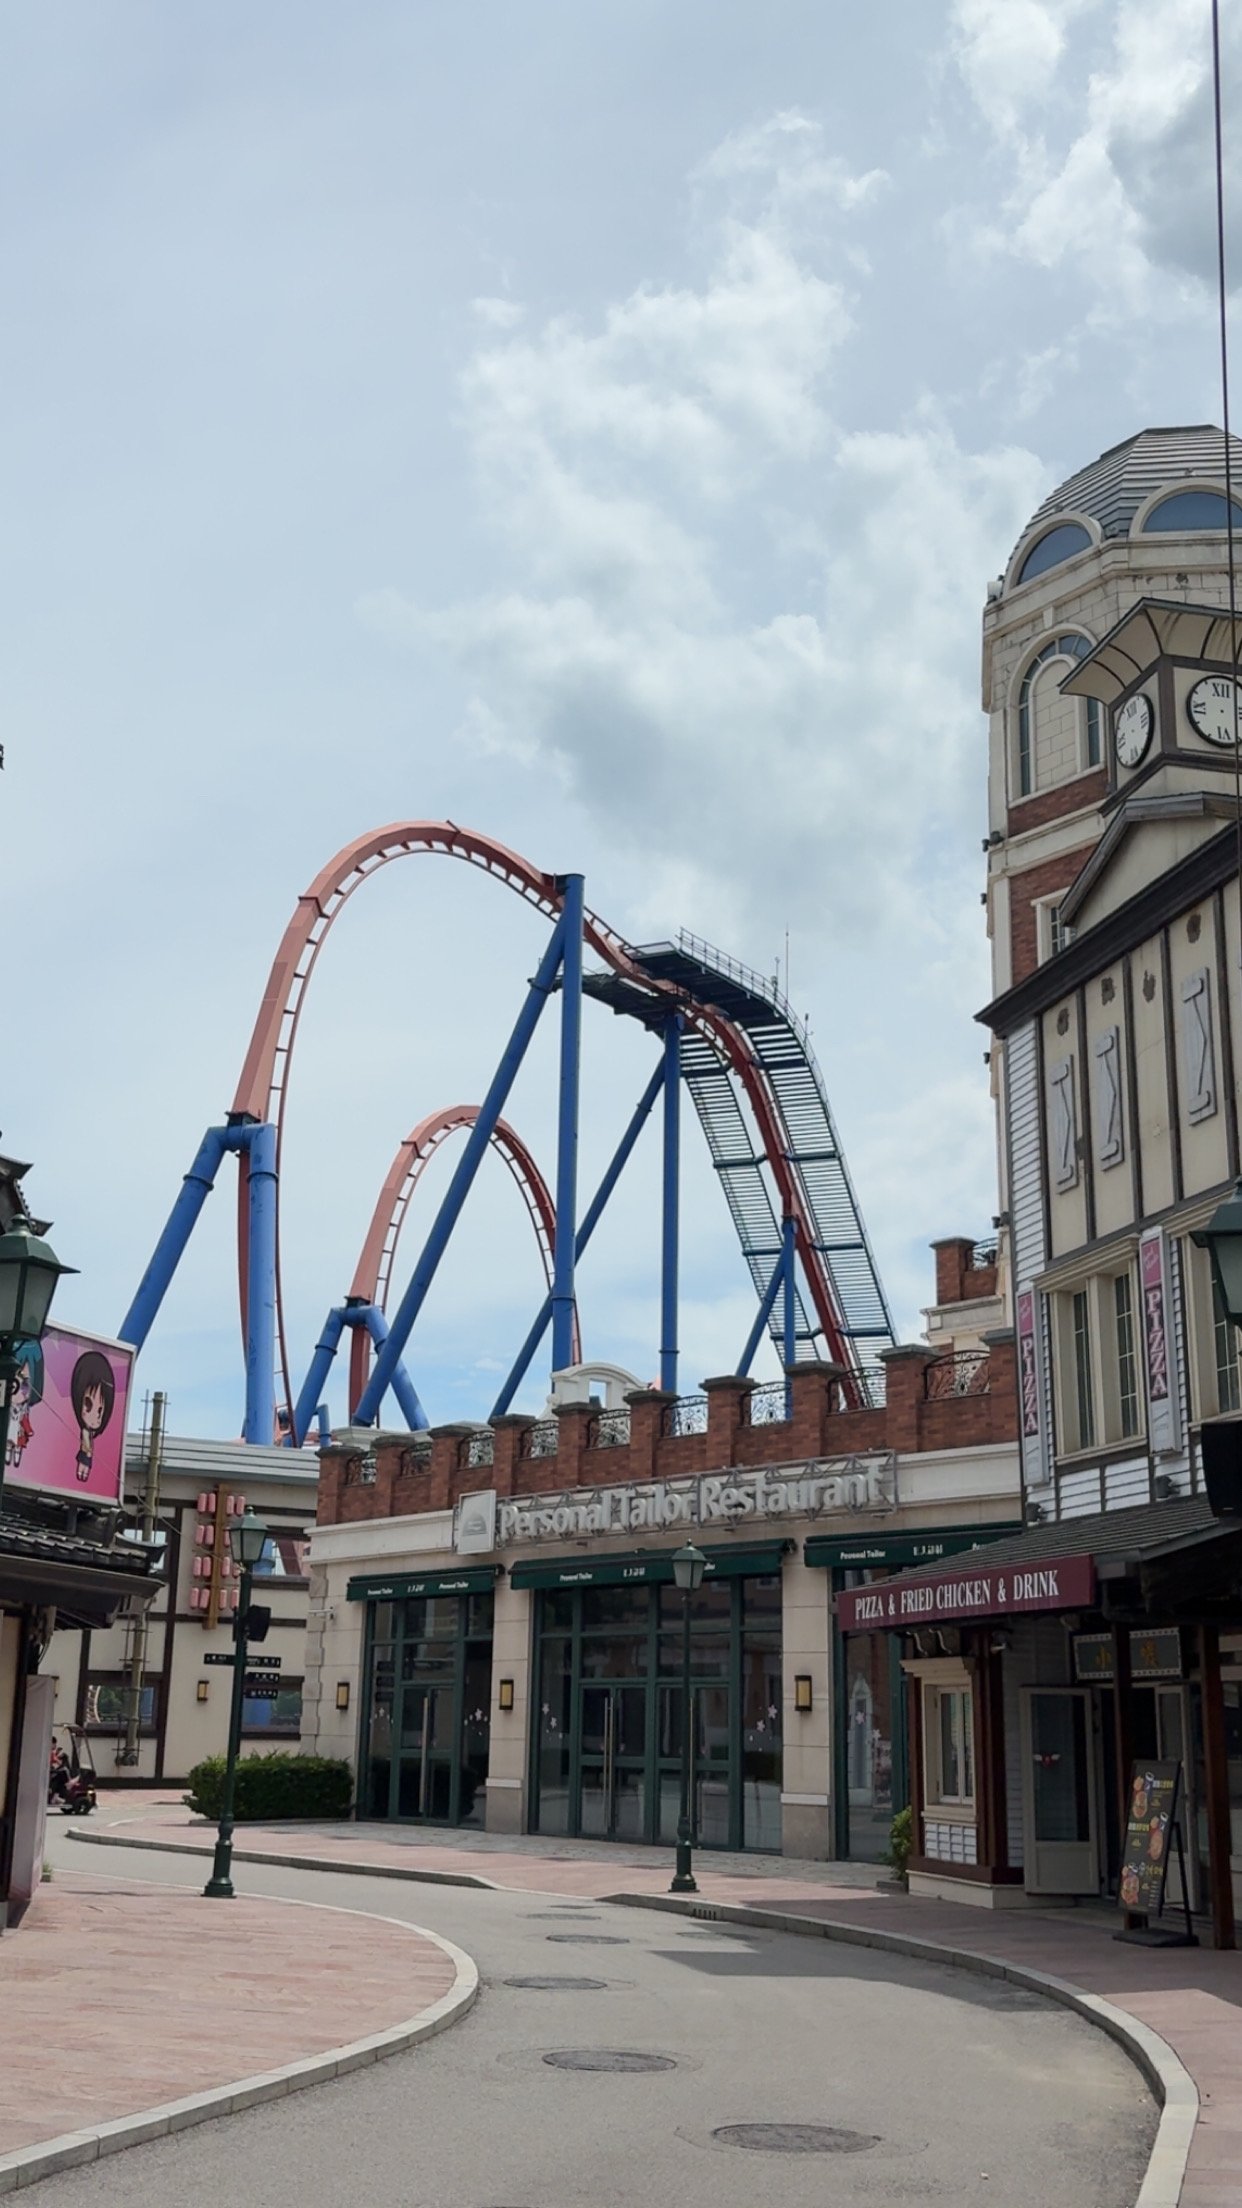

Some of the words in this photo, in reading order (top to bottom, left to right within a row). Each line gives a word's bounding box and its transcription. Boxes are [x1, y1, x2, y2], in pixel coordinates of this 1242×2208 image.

[1212, 683, 1231, 698] XII
[1147, 1291, 1167, 1395] PIZZA
[1022, 1338, 1038, 1433] PIZZA
[501, 1490, 612, 1539] Personal
[615, 1483, 696, 1526] Tailor
[700, 1464, 880, 1519] Restaurant
[855, 1596, 884, 1620] PIZZA
[888, 1593, 896, 1616] &
[901, 1588, 934, 1614] FRIED
[936, 1579, 991, 1609] CHICKEN
[998, 1577, 1006, 1602] &
[1013, 1570, 1059, 1600] DRINK
